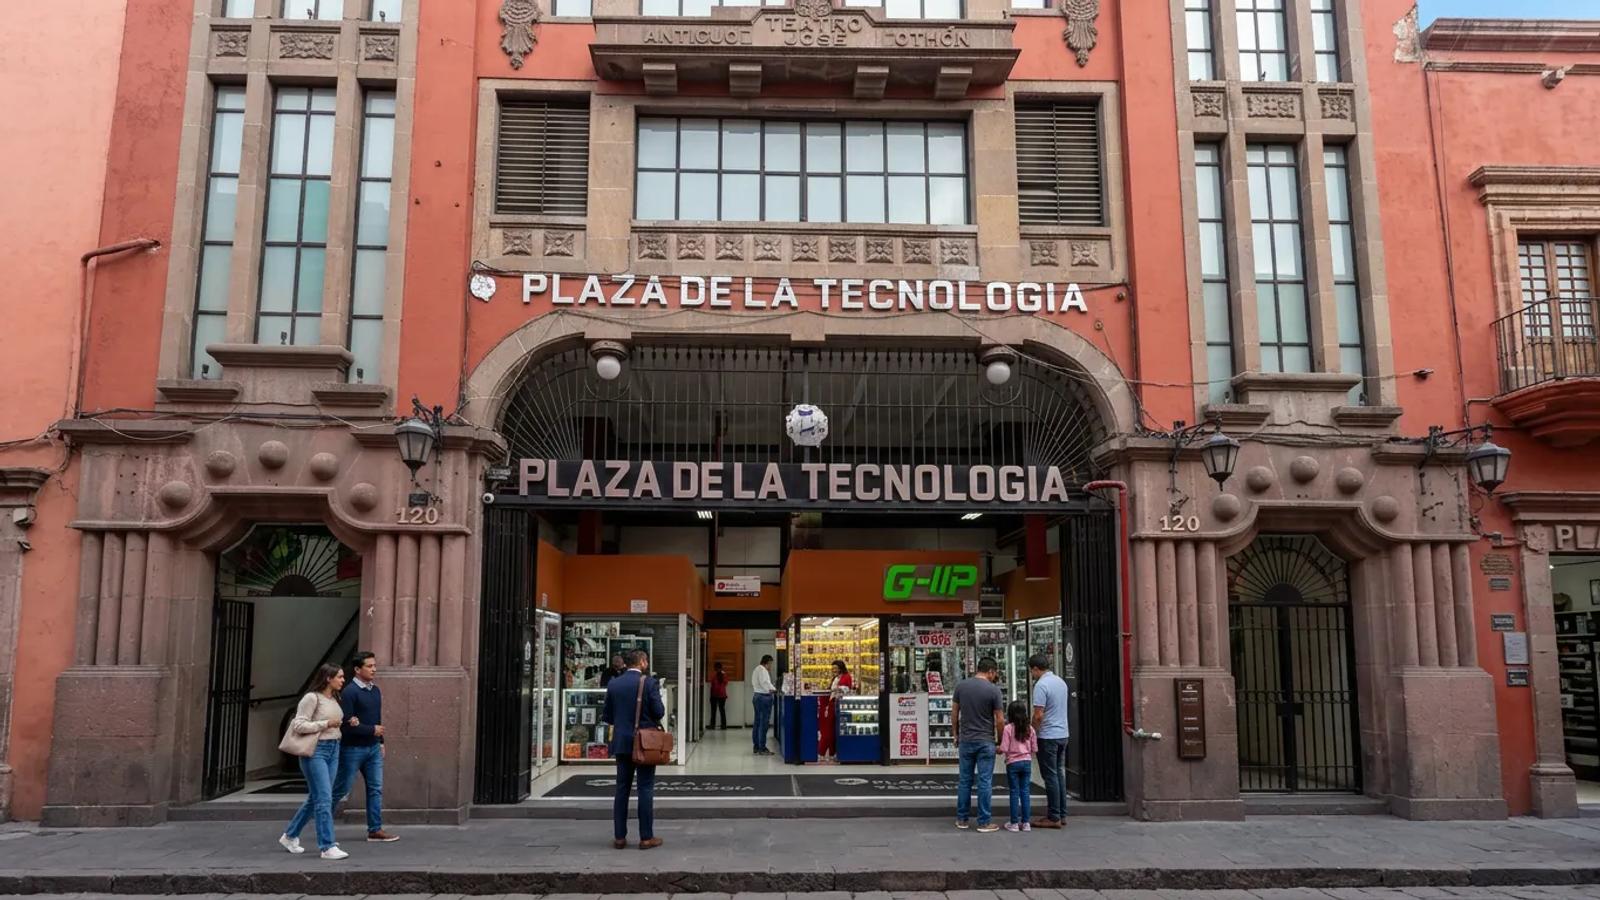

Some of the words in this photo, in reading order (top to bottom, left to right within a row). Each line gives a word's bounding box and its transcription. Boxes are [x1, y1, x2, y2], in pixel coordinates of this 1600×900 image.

[764, 17, 862, 33] TEATRO
[522, 273, 668, 306] PLAZA
[680, 275, 732, 308] DE
[744, 277, 799, 309] LA
[813, 279, 1089, 313] TECNOLOGIA
[518, 458, 662, 498] PLAZA
[672, 461, 724, 499] DE
[733, 462, 788, 500] LA
[801, 463, 1069, 502] TECNOLOGIA
[396, 507, 439, 524] 120
[1160, 515, 1200, 532] 120
[1554, 524, 1600, 549] PL
